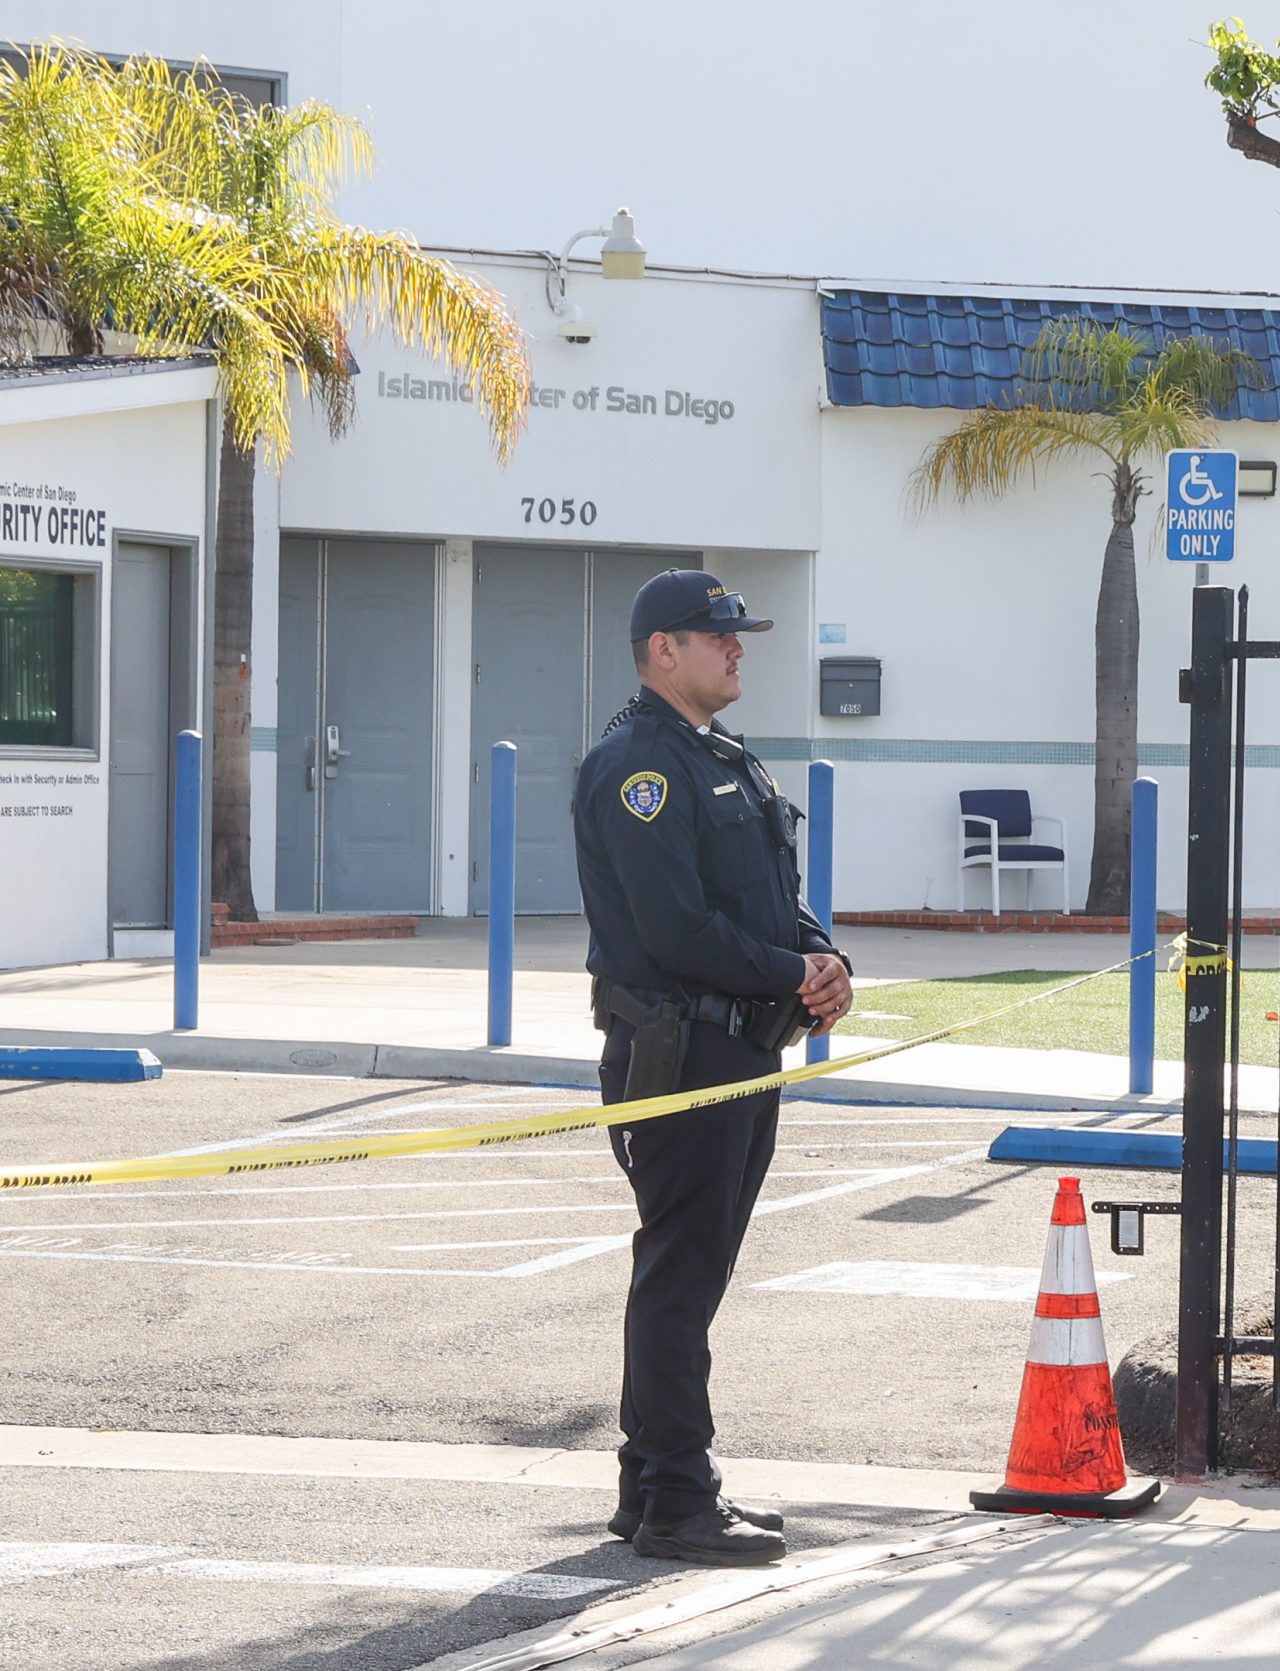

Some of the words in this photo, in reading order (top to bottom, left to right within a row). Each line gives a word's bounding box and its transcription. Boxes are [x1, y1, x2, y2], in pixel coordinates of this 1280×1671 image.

[378, 370, 473, 402] Islamic
[572, 386, 600, 411] of
[606, 386, 657, 415] San
[665, 390, 735, 425] Diego
[13, 482, 35, 499] Center
[36, 485, 43, 499] of
[45, 485, 57, 501] San
[58, 486, 77, 505] Diego
[521, 497, 597, 526] 7050
[1168, 508, 1234, 530] PARKING
[3, 503, 42, 543] RITY
[48, 506, 106, 547] OFFICE
[1180, 534, 1220, 556] ONLY
[840, 704, 861, 714] 7050
[34, 774, 57, 787] Security
[65, 774, 82, 784] Admin
[84, 774, 99, 785] Office
[1, 806, 12, 817] ARE
[14, 806, 39, 817] SUBJECT
[42, 806, 48, 817] TO
[50, 805, 73, 816] SEARCH
